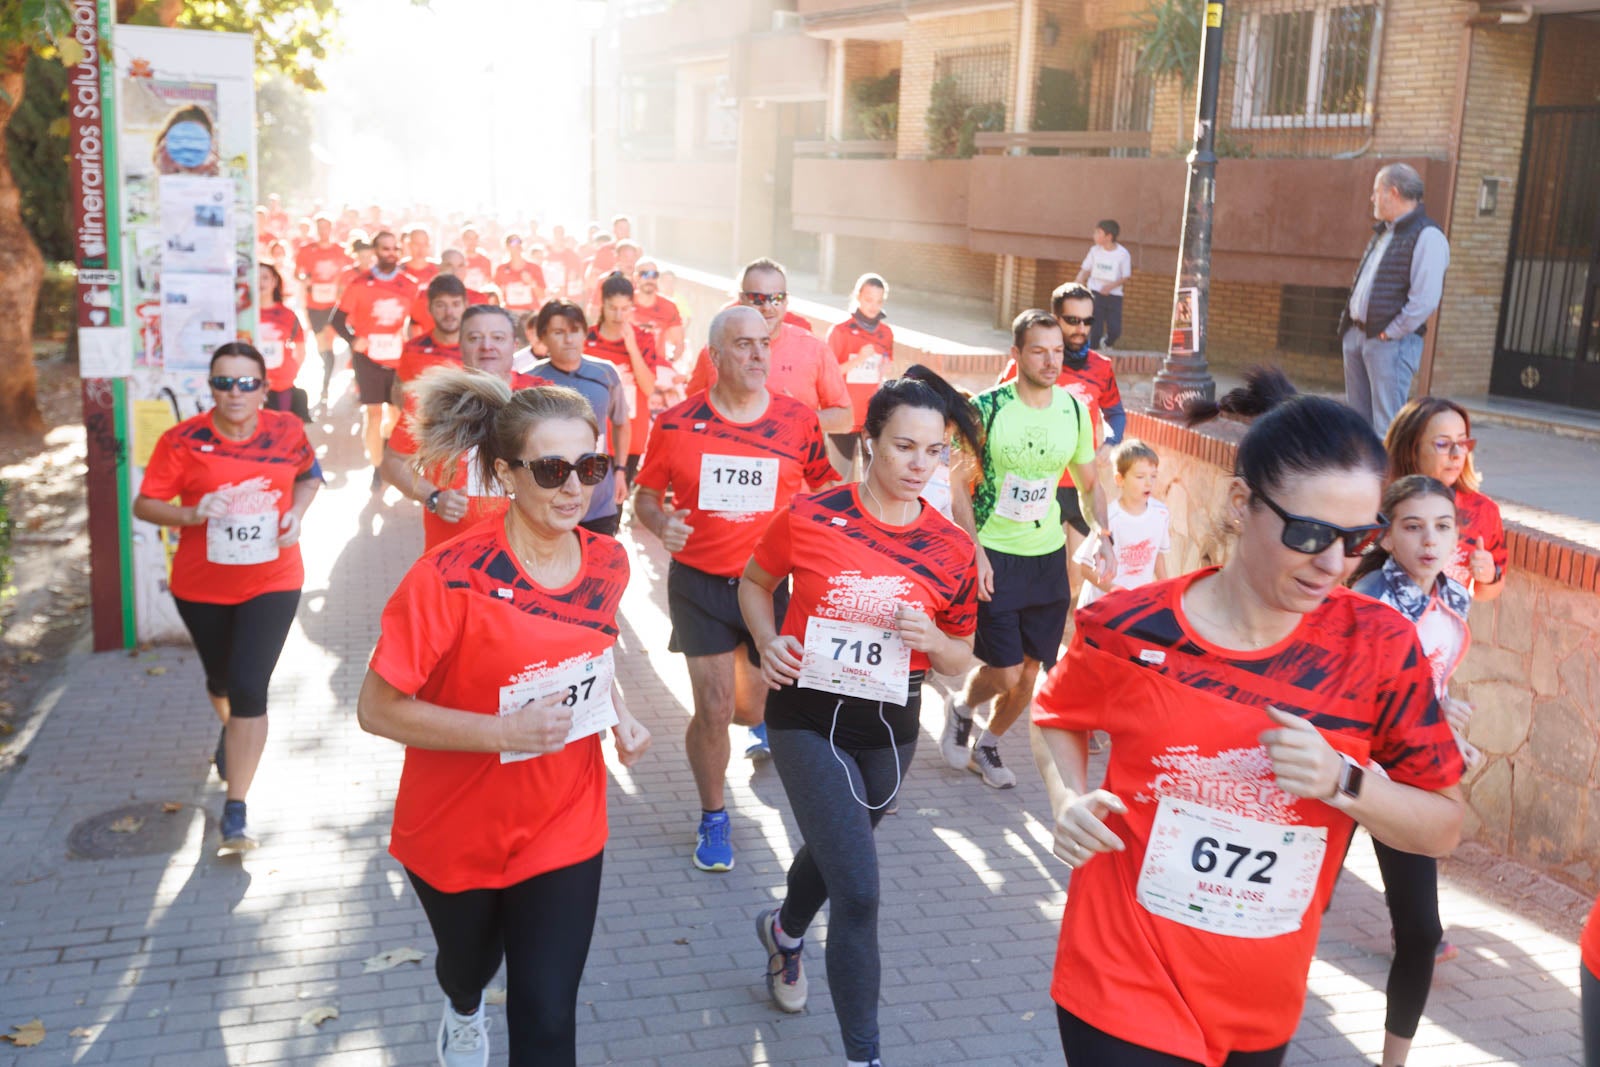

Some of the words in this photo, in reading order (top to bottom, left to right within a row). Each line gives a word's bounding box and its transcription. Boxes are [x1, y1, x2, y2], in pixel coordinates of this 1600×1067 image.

[713, 468, 762, 486] 1788
[1012, 487, 1047, 502] 1302
[225, 526, 261, 541] 162
[831, 637, 882, 666] 718
[842, 666, 873, 677] LINDSAY
[1191, 836, 1277, 884] 672
[1197, 880, 1231, 899] MARIA
